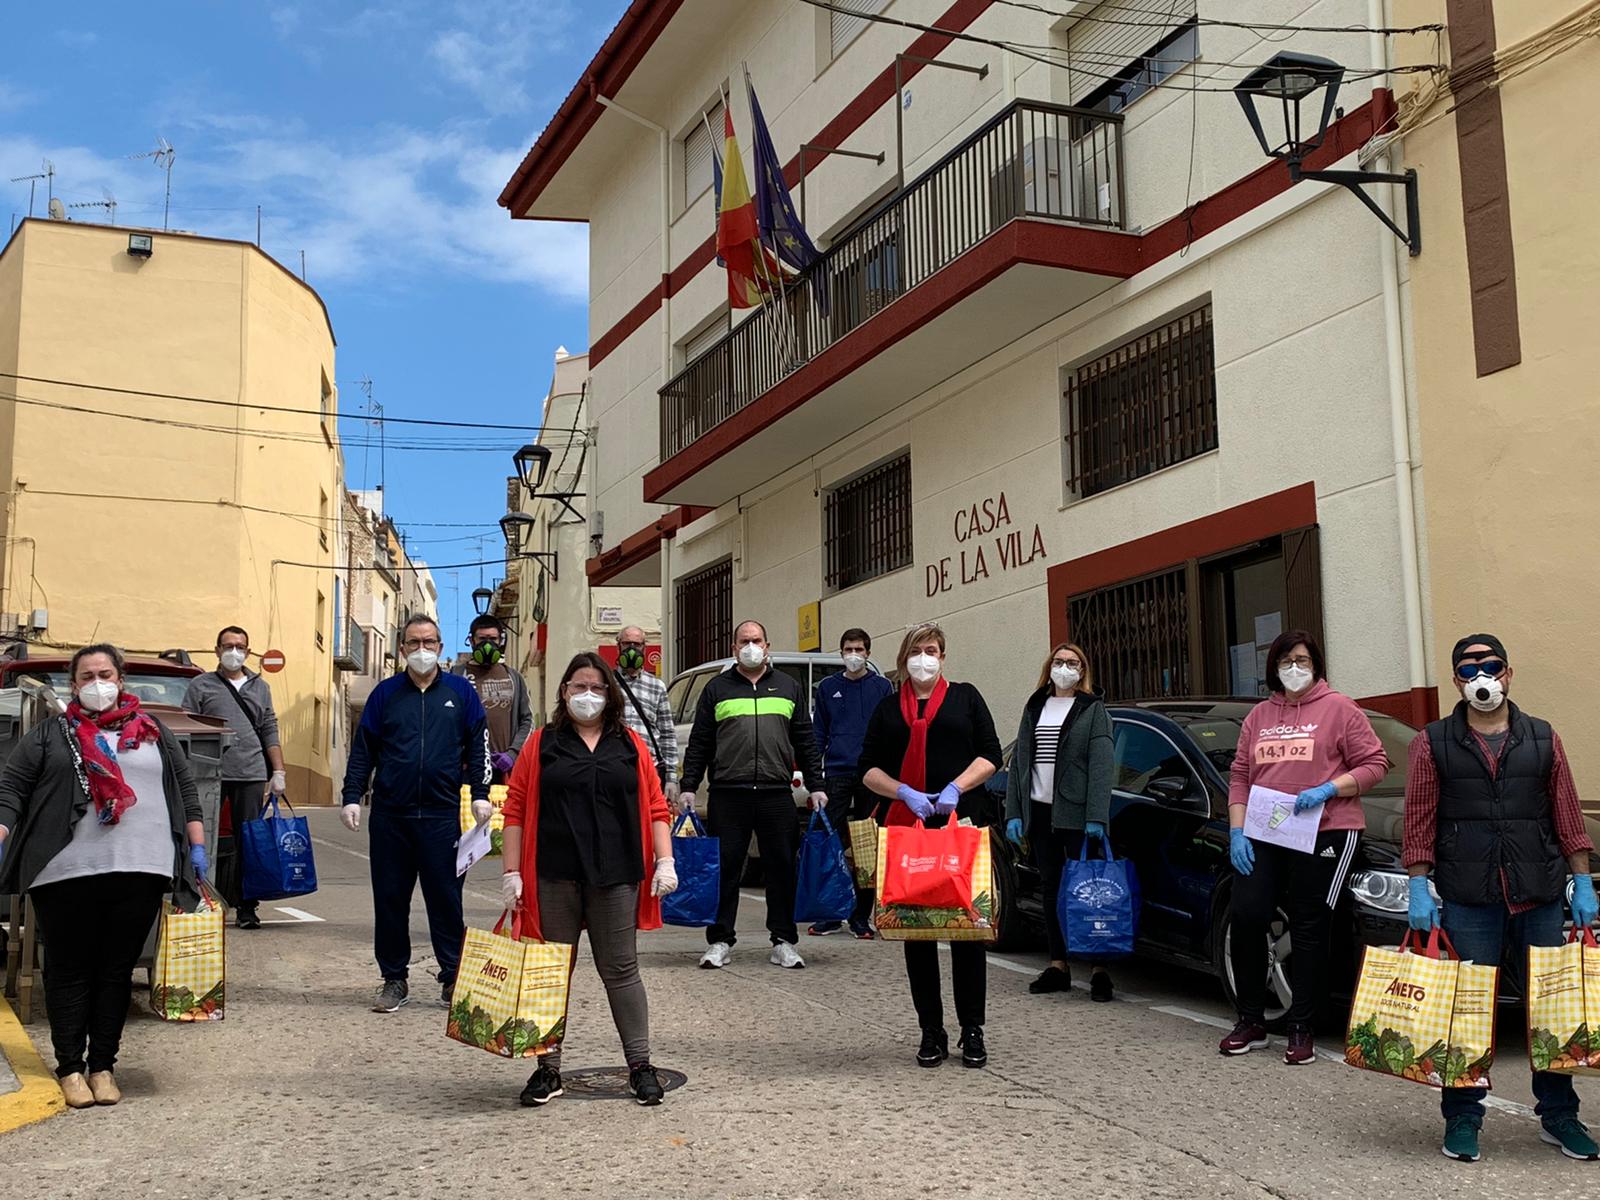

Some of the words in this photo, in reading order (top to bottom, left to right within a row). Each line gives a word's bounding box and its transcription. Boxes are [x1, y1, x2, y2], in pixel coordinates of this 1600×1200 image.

[955, 492, 1011, 543] CASA
[926, 557, 952, 597] DE
[961, 545, 989, 585] LA
[995, 523, 1047, 571] VILA
[1259, 724, 1299, 736] adidas
[1258, 745, 1285, 758] 14.1
[1290, 746, 1307, 756] oz
[480, 958, 508, 982] ANETO
[1385, 977, 1425, 1002] ANETO
[1393, 1001, 1420, 1013] NATURAL
